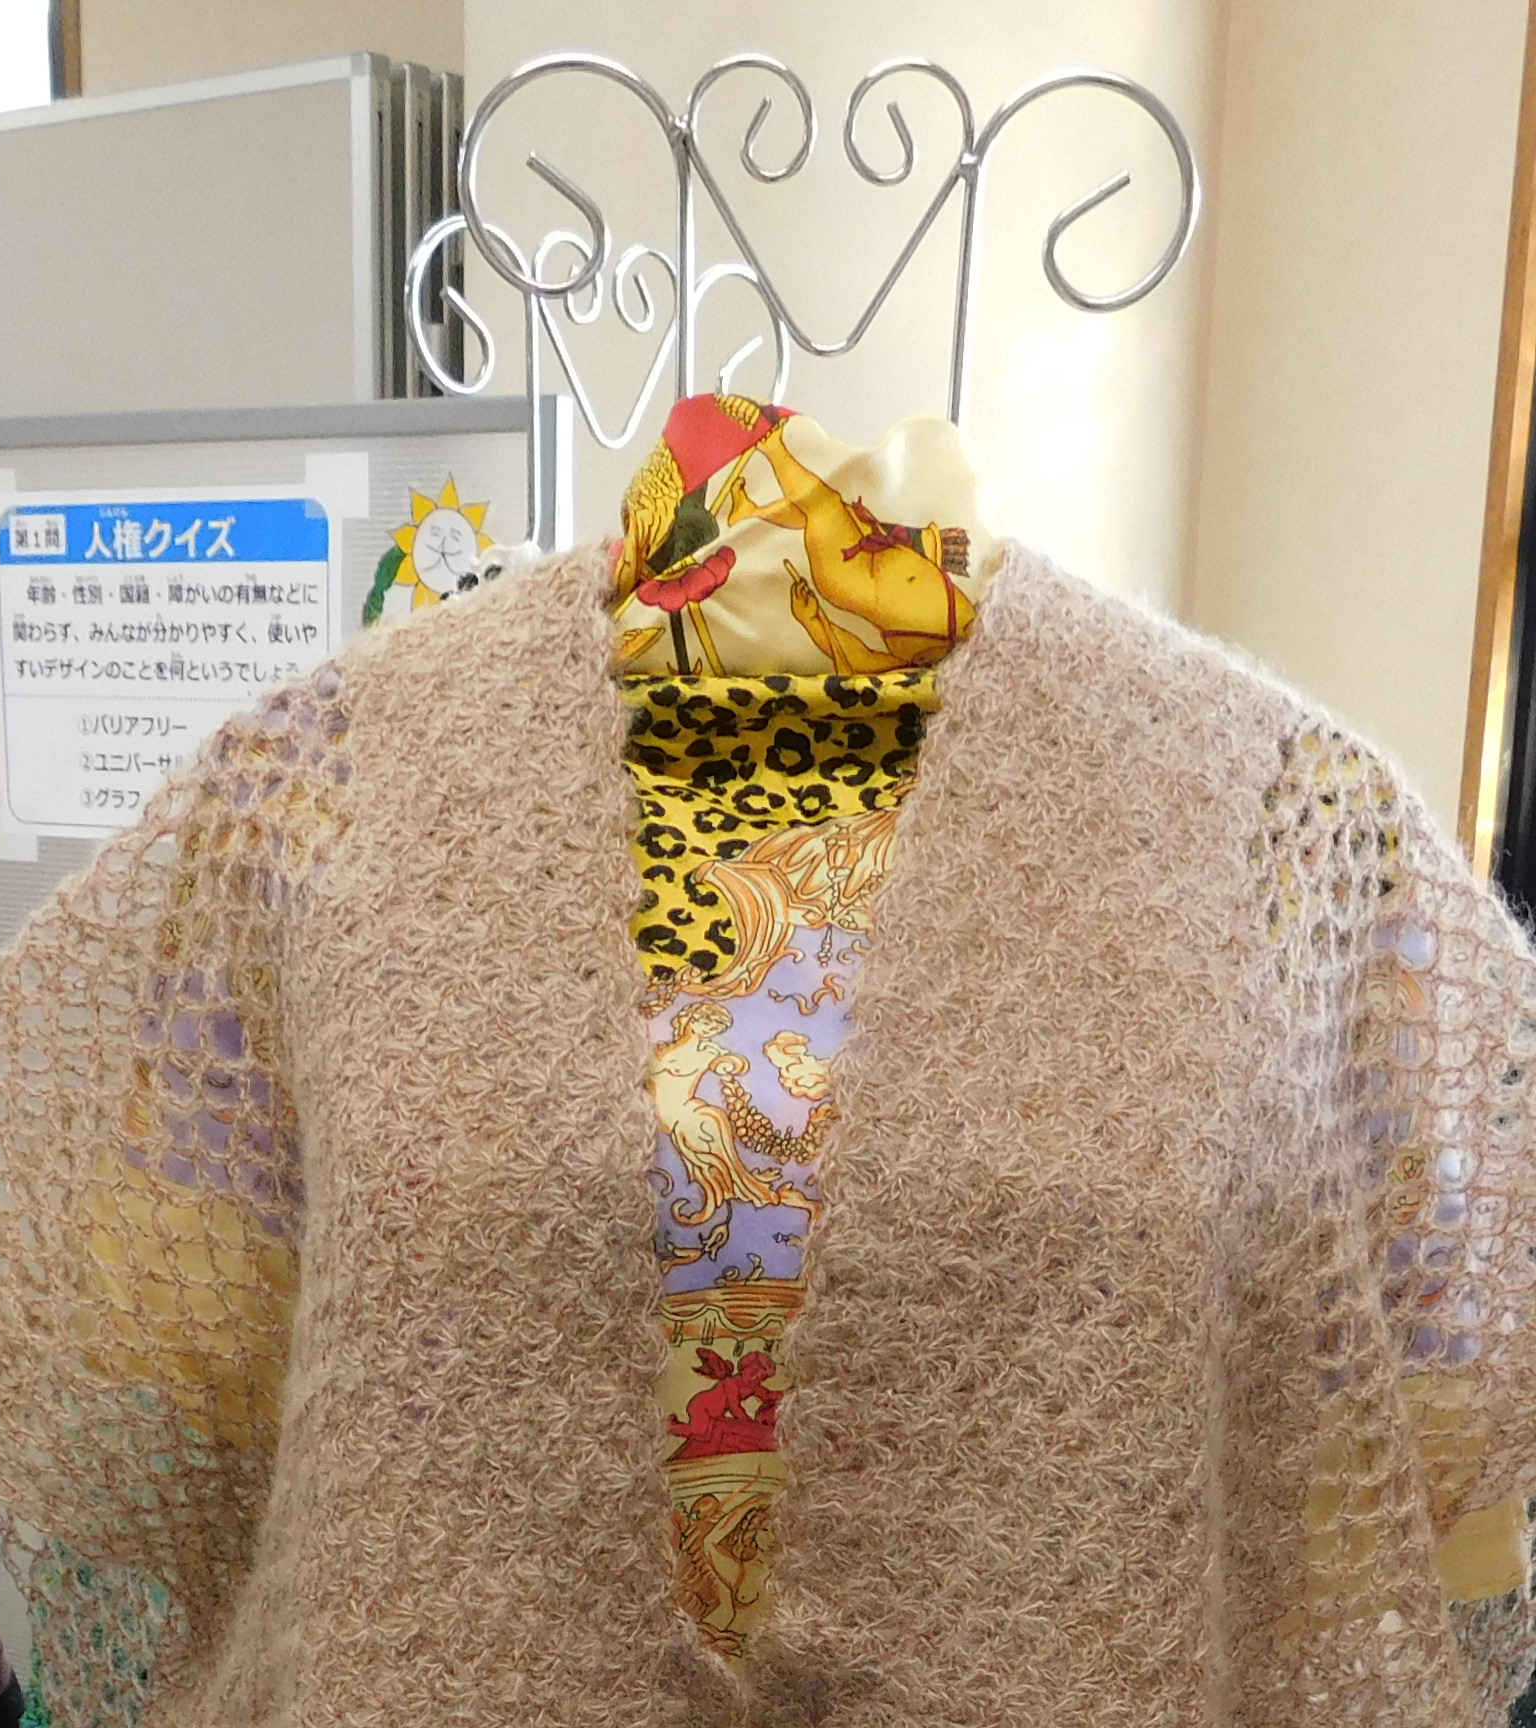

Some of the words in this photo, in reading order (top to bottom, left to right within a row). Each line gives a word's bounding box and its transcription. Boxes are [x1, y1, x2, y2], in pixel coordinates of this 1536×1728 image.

[84, 515, 237, 560] 人権クイズ
